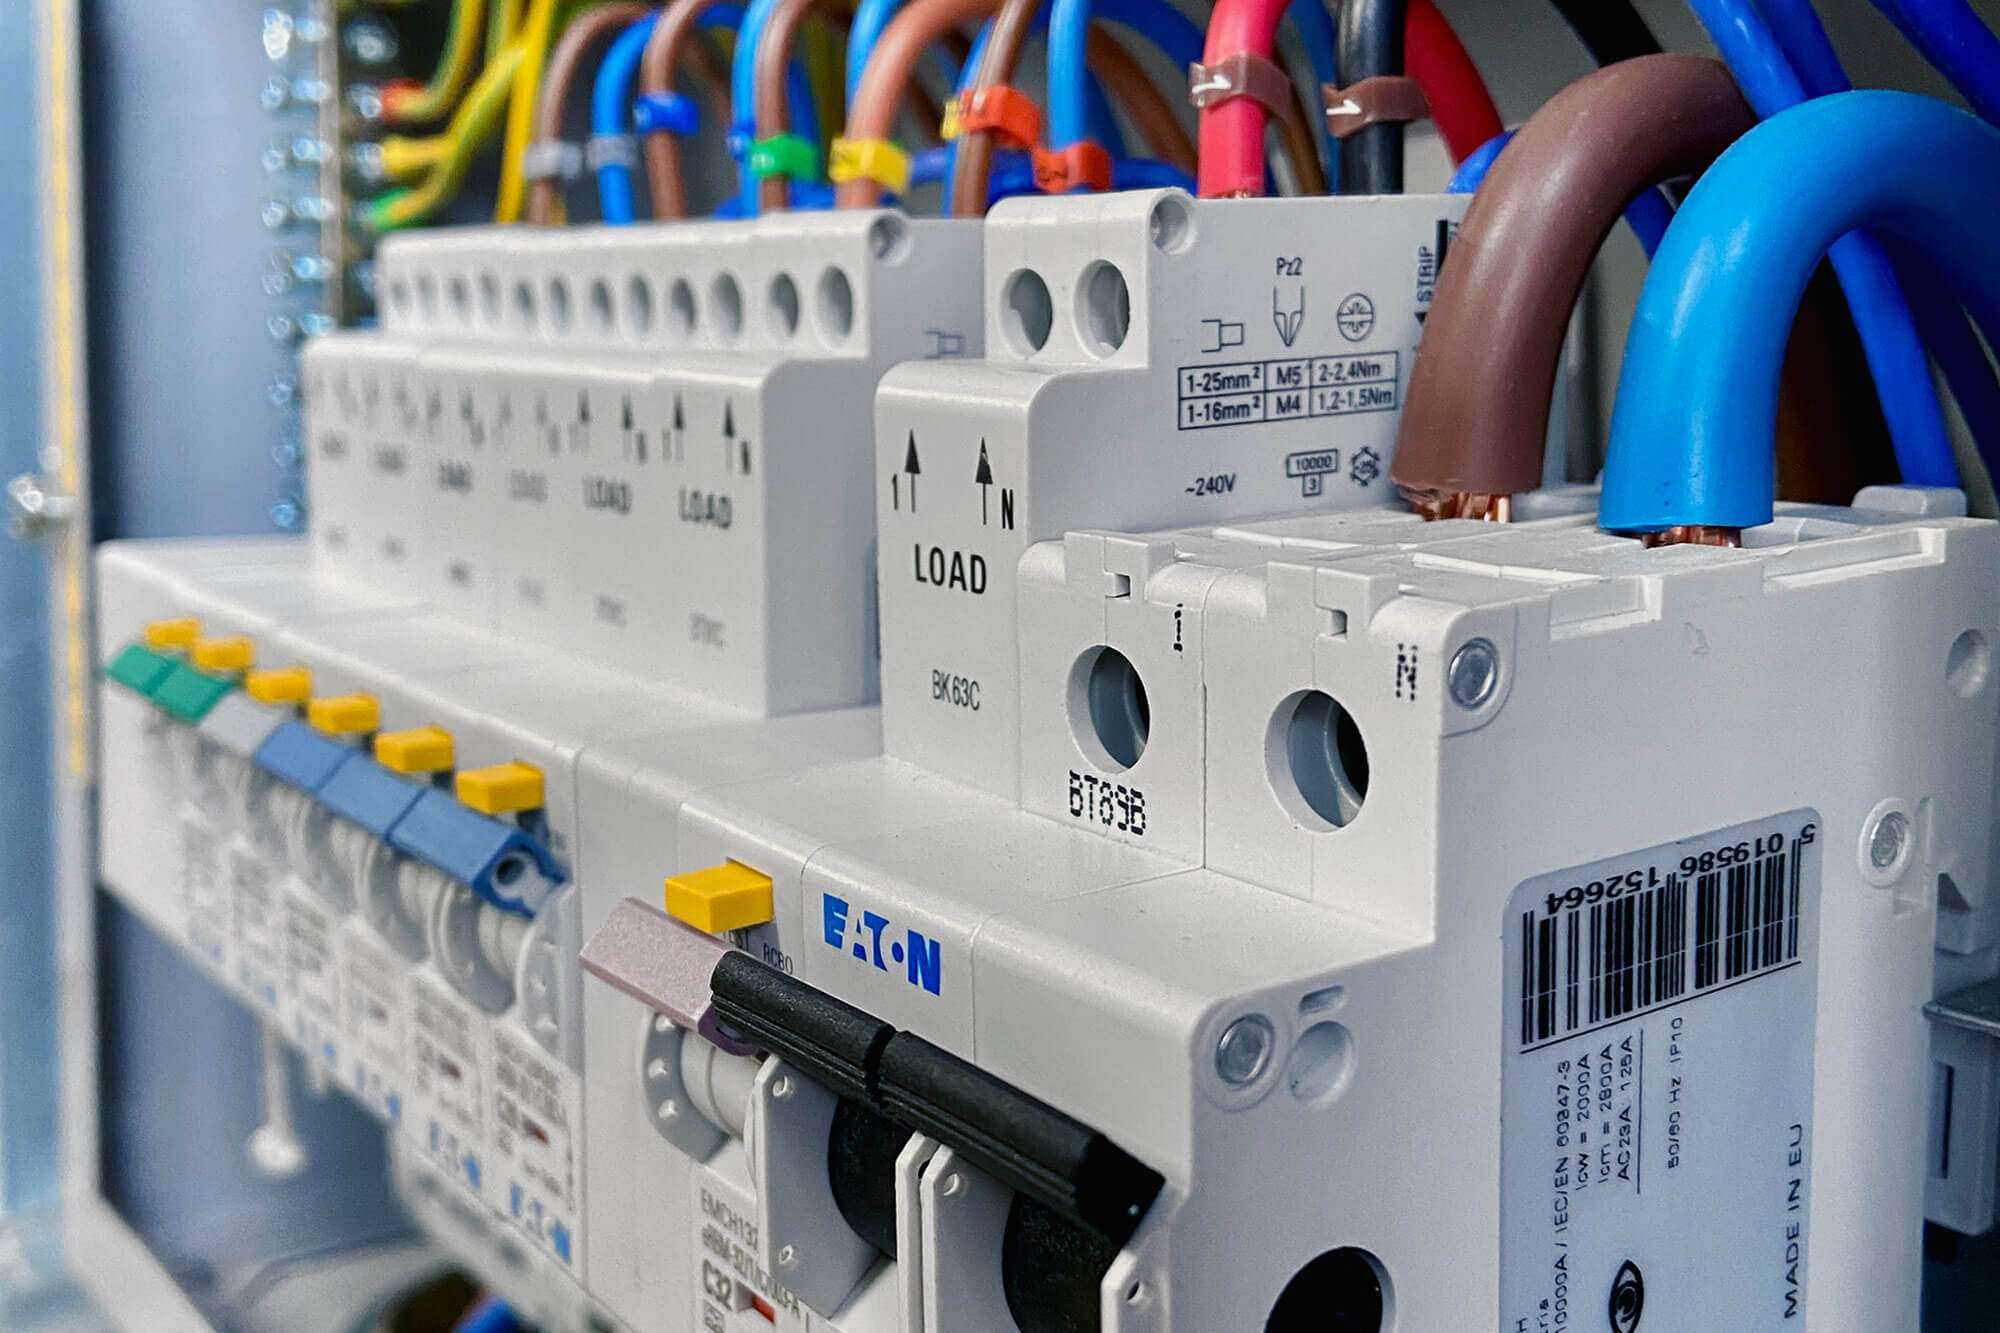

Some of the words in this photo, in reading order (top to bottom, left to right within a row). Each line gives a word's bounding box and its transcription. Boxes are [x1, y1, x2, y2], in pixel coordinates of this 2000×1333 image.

[1276, 257, 1302, 276] Pz2
[1416, 246, 1434, 302] STRIP
[1276, 366, 1301, 385] M5
[1276, 395, 1301, 414] M4
[1295, 456, 1331, 470] 10000
[1309, 478, 1317, 491] 3
[678, 486, 732, 529] LOAD
[1001, 488, 1014, 530] N
[914, 543, 987, 594] LOAD
[932, 669, 980, 711] BK63C
[1396, 643, 1418, 702] N
[1679, 833, 1783, 878] 019586
[1799, 823, 1816, 845] 5
[1546, 866, 1660, 914] 152664
[763, 943, 793, 975] RCBO
[822, 893, 941, 996] EATON
[1599, 1044, 1613, 1112] 2800A
[1620, 1035, 1633, 1091] 125A
[1577, 1053, 1591, 1122] 2000A
[1669, 1076, 1681, 1104] Hz
[1618, 1105, 1632, 1181] AC23A
[1788, 1123, 1802, 1166] EU
[1787, 1179, 1801, 1211] IN
[703, 1258, 733, 1312] C32
[1784, 1222, 1800, 1319] MADE
